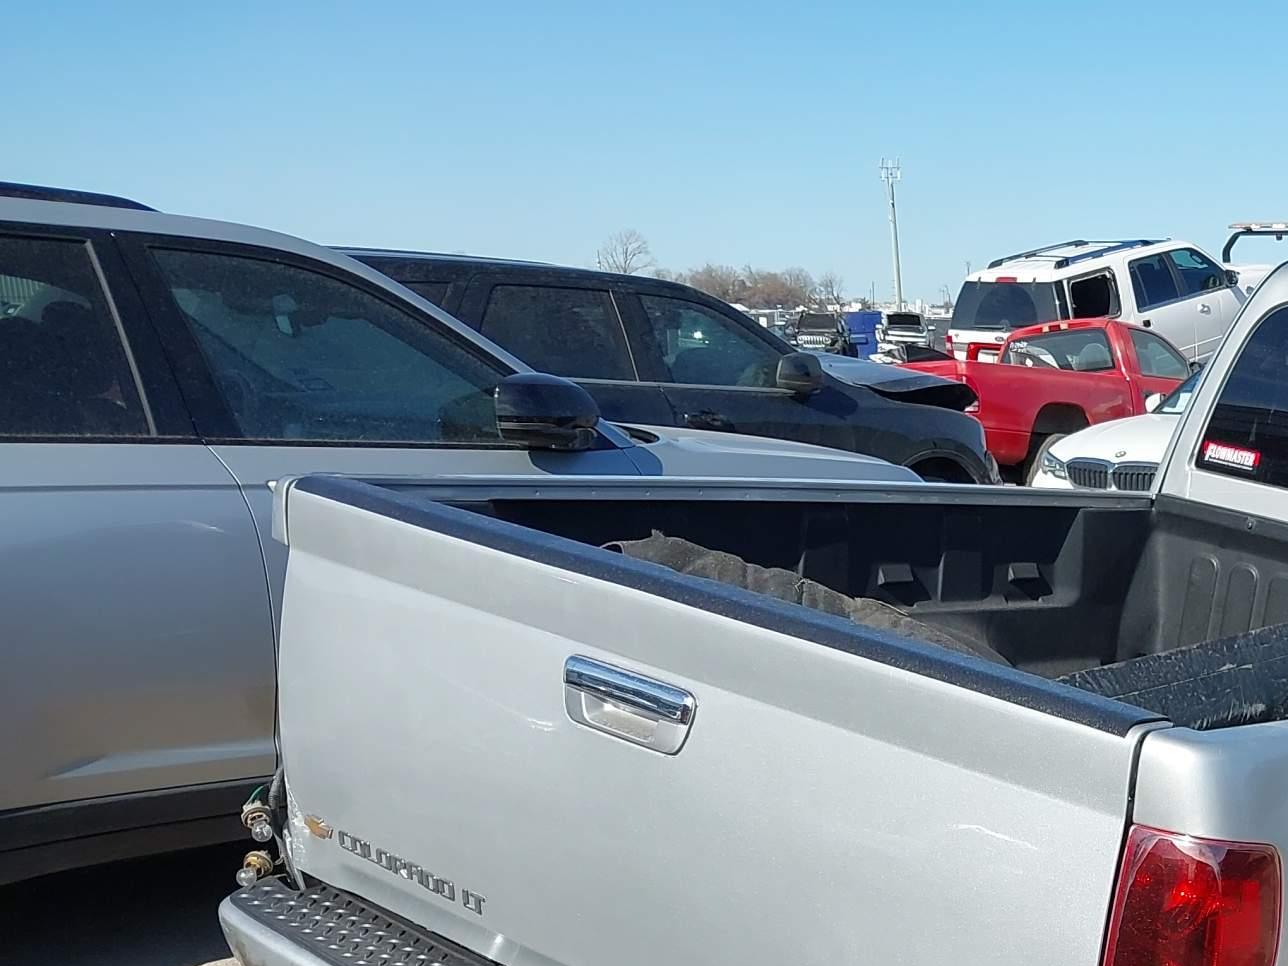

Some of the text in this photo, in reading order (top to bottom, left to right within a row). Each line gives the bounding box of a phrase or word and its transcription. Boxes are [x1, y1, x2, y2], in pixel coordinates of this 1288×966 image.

[1204, 443, 1255, 467] FLOWMASTER
[338, 830, 487, 915] COLORADO LT
